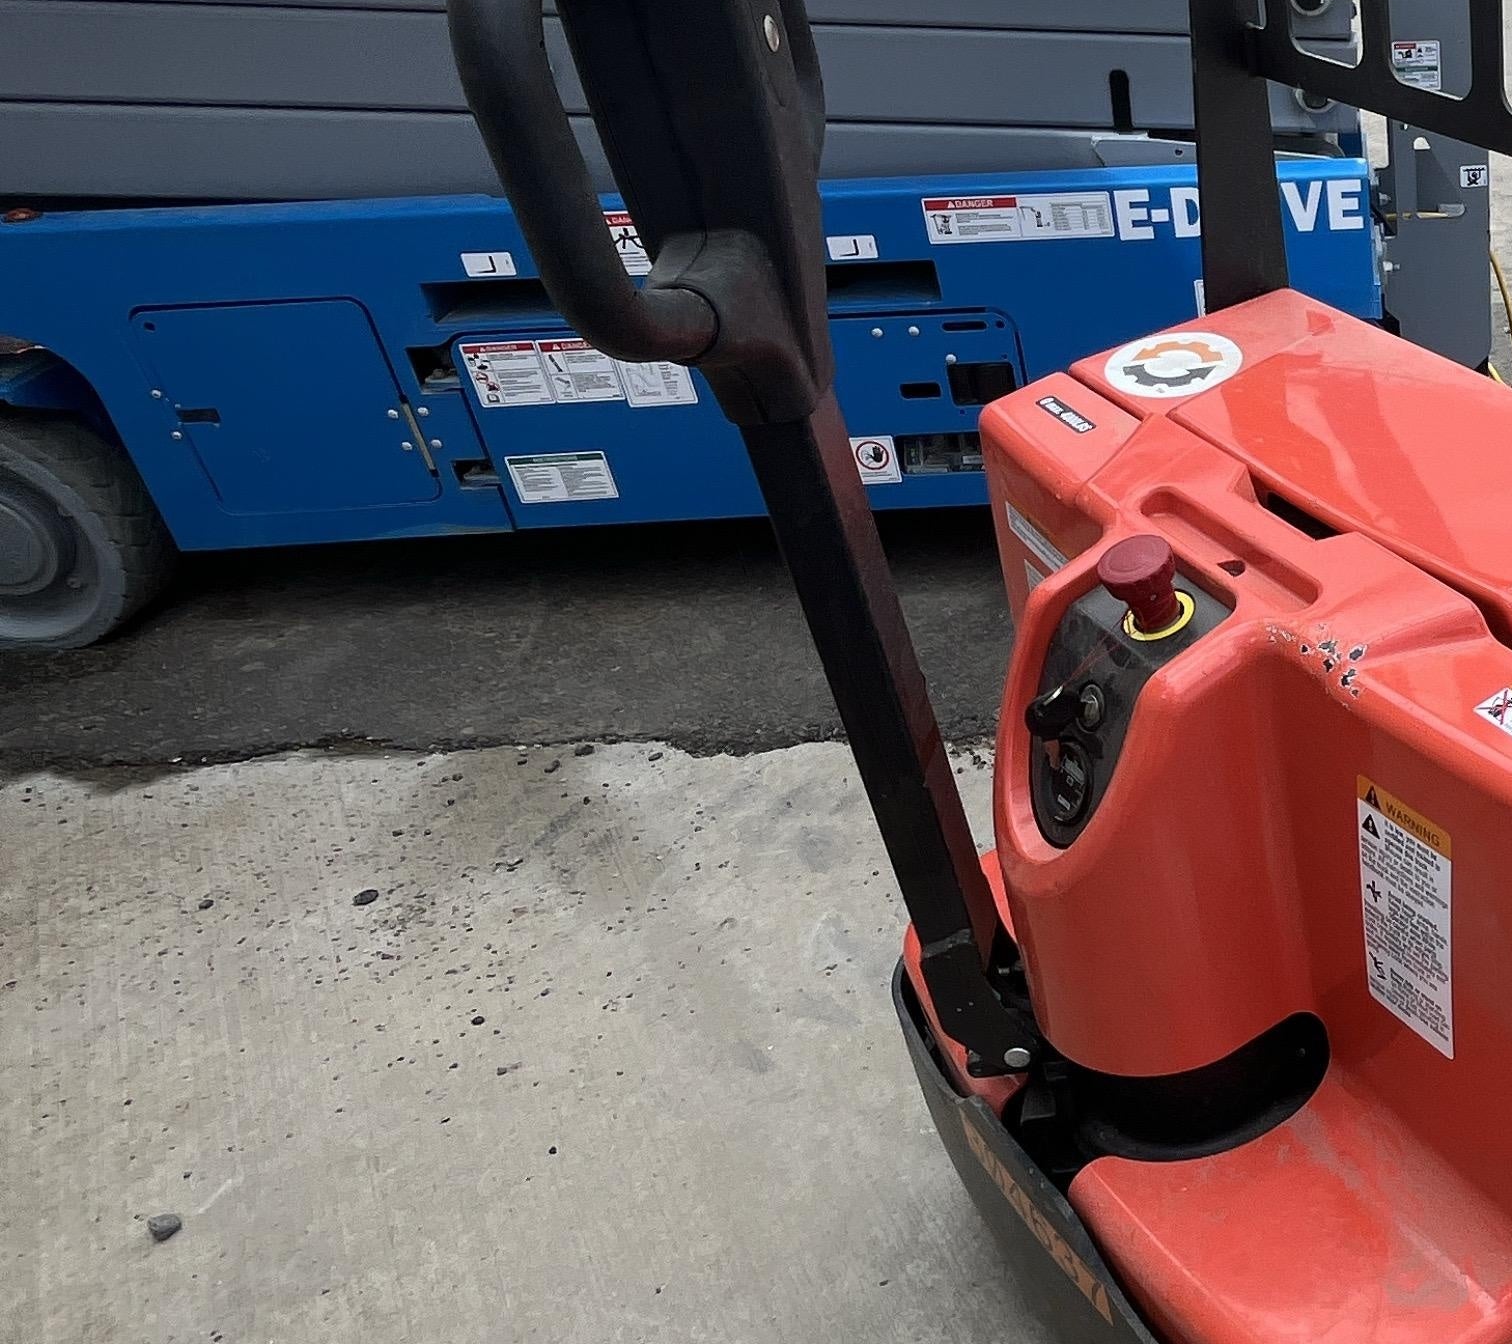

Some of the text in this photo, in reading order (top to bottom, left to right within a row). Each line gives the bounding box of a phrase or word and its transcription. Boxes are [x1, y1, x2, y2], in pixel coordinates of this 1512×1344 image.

[954, 198, 995, 209] DANGER
[1113, 179, 1365, 241] E-DVE
[1385, 800, 1440, 847] WARNING
